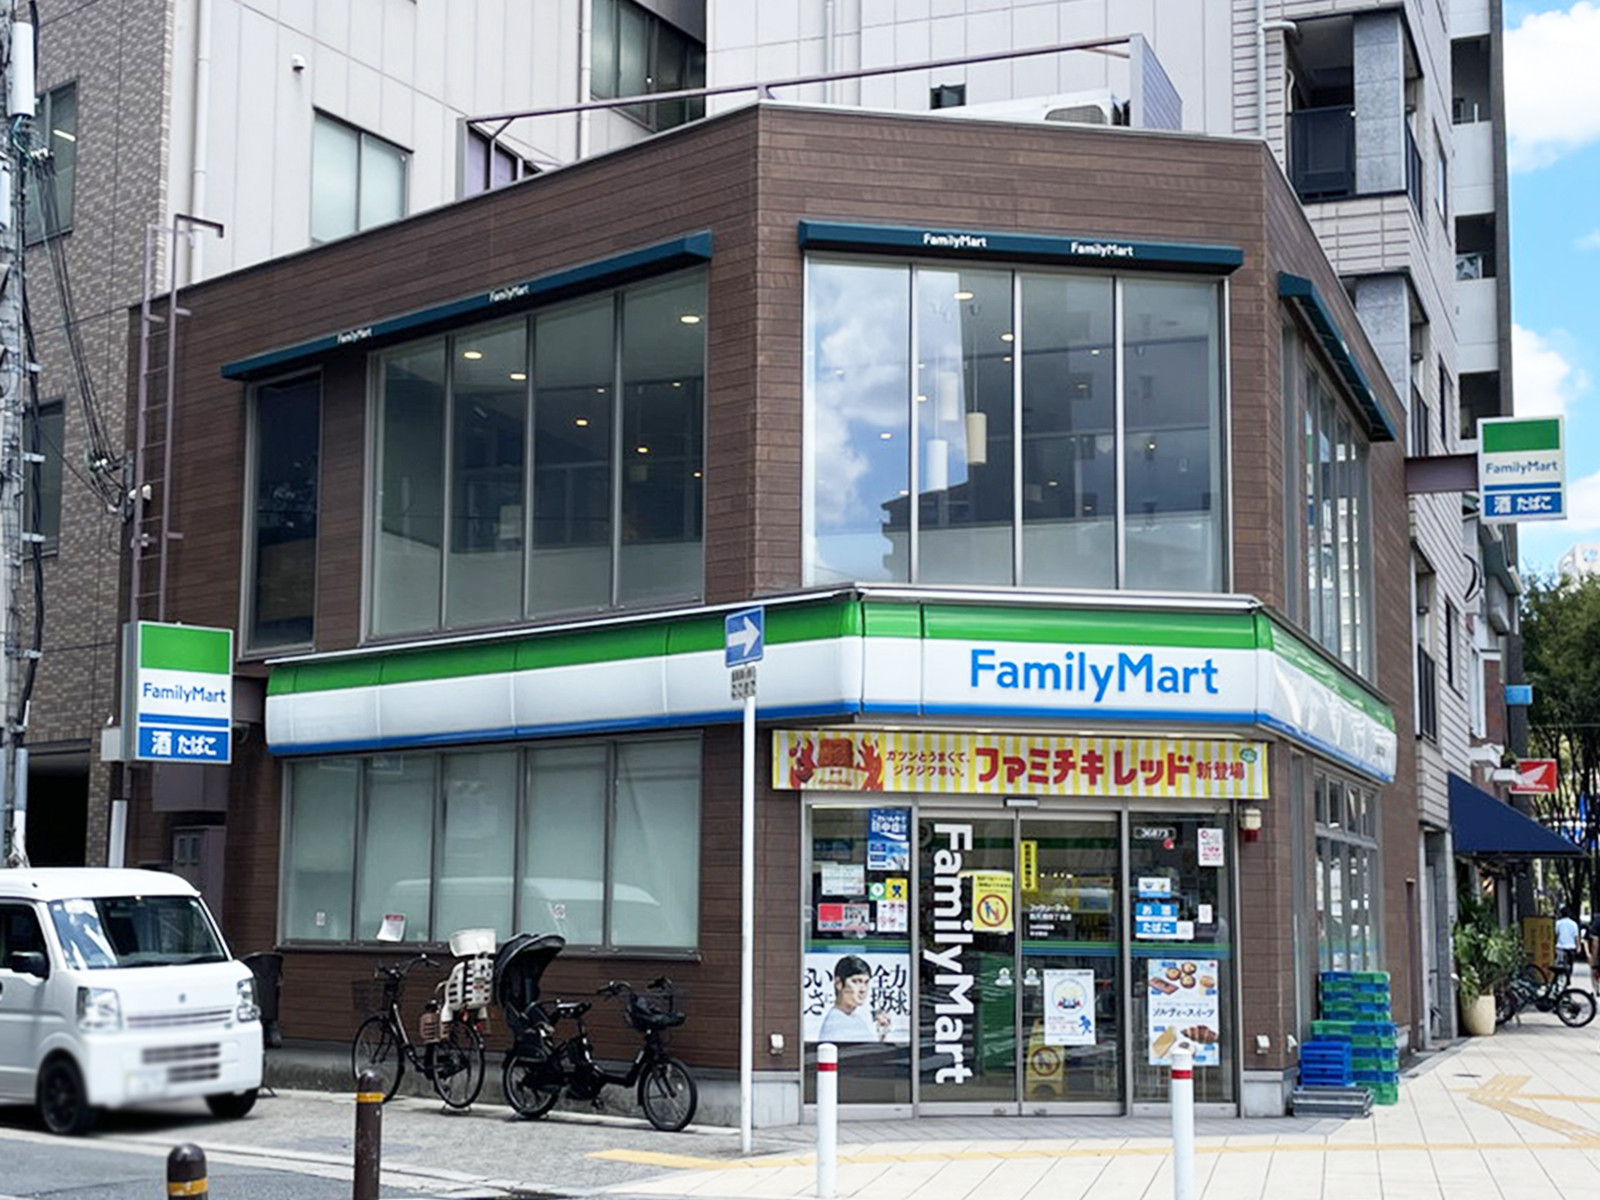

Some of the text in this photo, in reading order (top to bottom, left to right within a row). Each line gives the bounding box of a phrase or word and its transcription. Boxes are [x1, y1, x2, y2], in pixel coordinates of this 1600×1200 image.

[923, 233, 987, 250] FamilyMart
[1070, 242, 1134, 258] FamilyMart
[488, 284, 531, 303] FamilyMart
[336, 327, 374, 344] FamilyMart
[1485, 460, 1559, 475] FamilyMart
[1493, 495, 1552, 514] 酒 たばこ
[970, 648, 1219, 703] FamilyMart
[142, 682, 227, 704] FamilyMart
[151, 730, 217, 757] 酒 たばこ
[1142, 922, 1171, 933] たばこ
[923, 822, 975, 1085] FamilyMart
[871, 963, 907, 990] 全力
